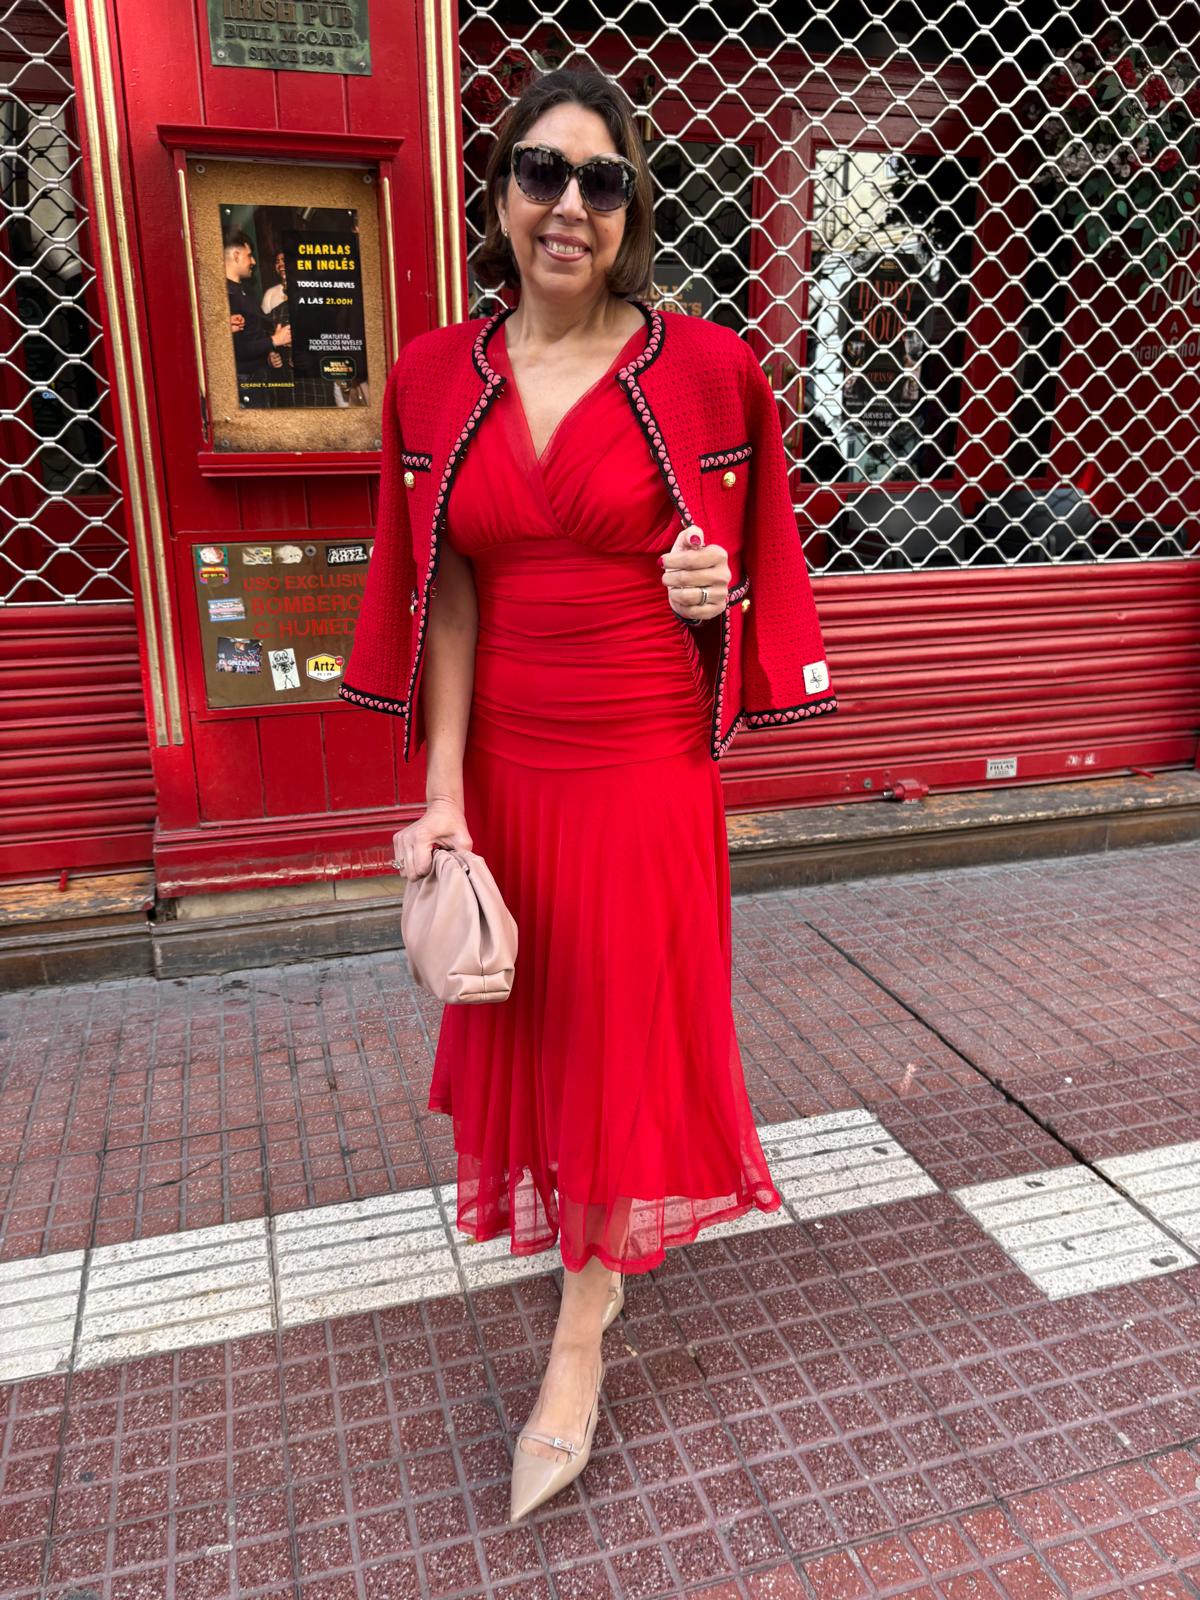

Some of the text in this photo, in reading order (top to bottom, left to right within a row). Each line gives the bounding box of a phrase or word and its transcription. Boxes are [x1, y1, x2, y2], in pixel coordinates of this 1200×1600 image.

[223, 0, 353, 28] IRISH PUB
[223, 24, 273, 42] BULL
[249, 47, 298, 63] SINCE
[298, 244, 351, 255] CHARLAS
[297, 257, 355, 270] EN INGLÉS
[243, 577, 280, 592] USO
[313, 661, 335, 671] Artz
